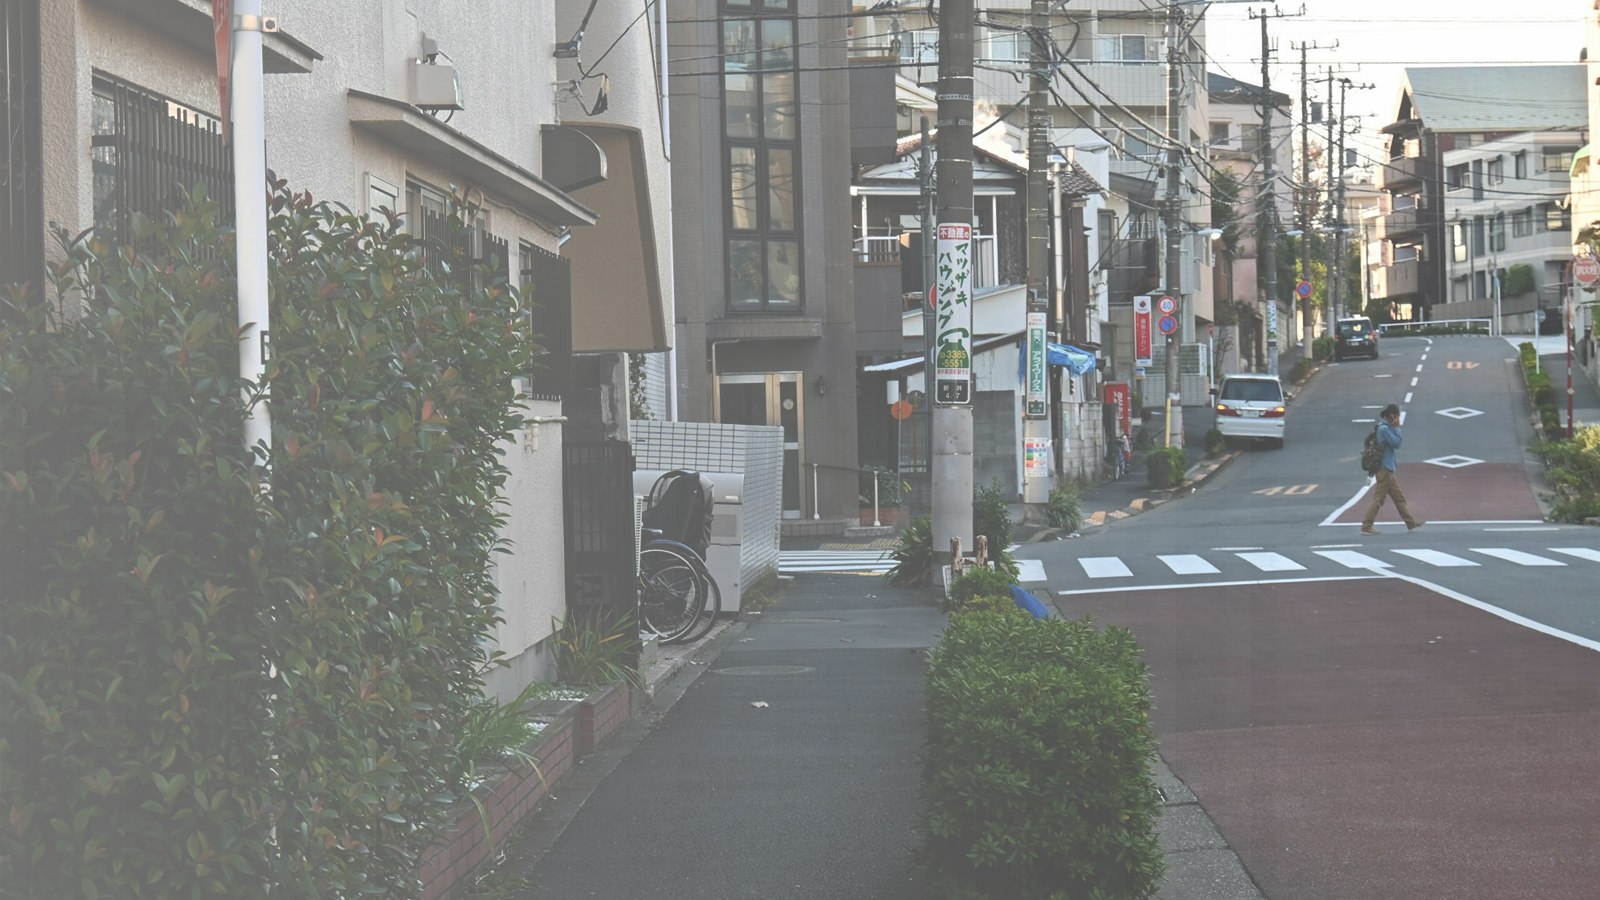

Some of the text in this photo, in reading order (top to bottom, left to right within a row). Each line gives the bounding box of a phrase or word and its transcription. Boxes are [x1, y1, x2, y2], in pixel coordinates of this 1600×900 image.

[940, 227, 969, 239] 不動産の
[954, 242, 970, 308] マツザキ
[938, 252, 954, 330] ハウジング
[1162, 301, 1172, 310] 40
[1251, 484, 1319, 496] 40
